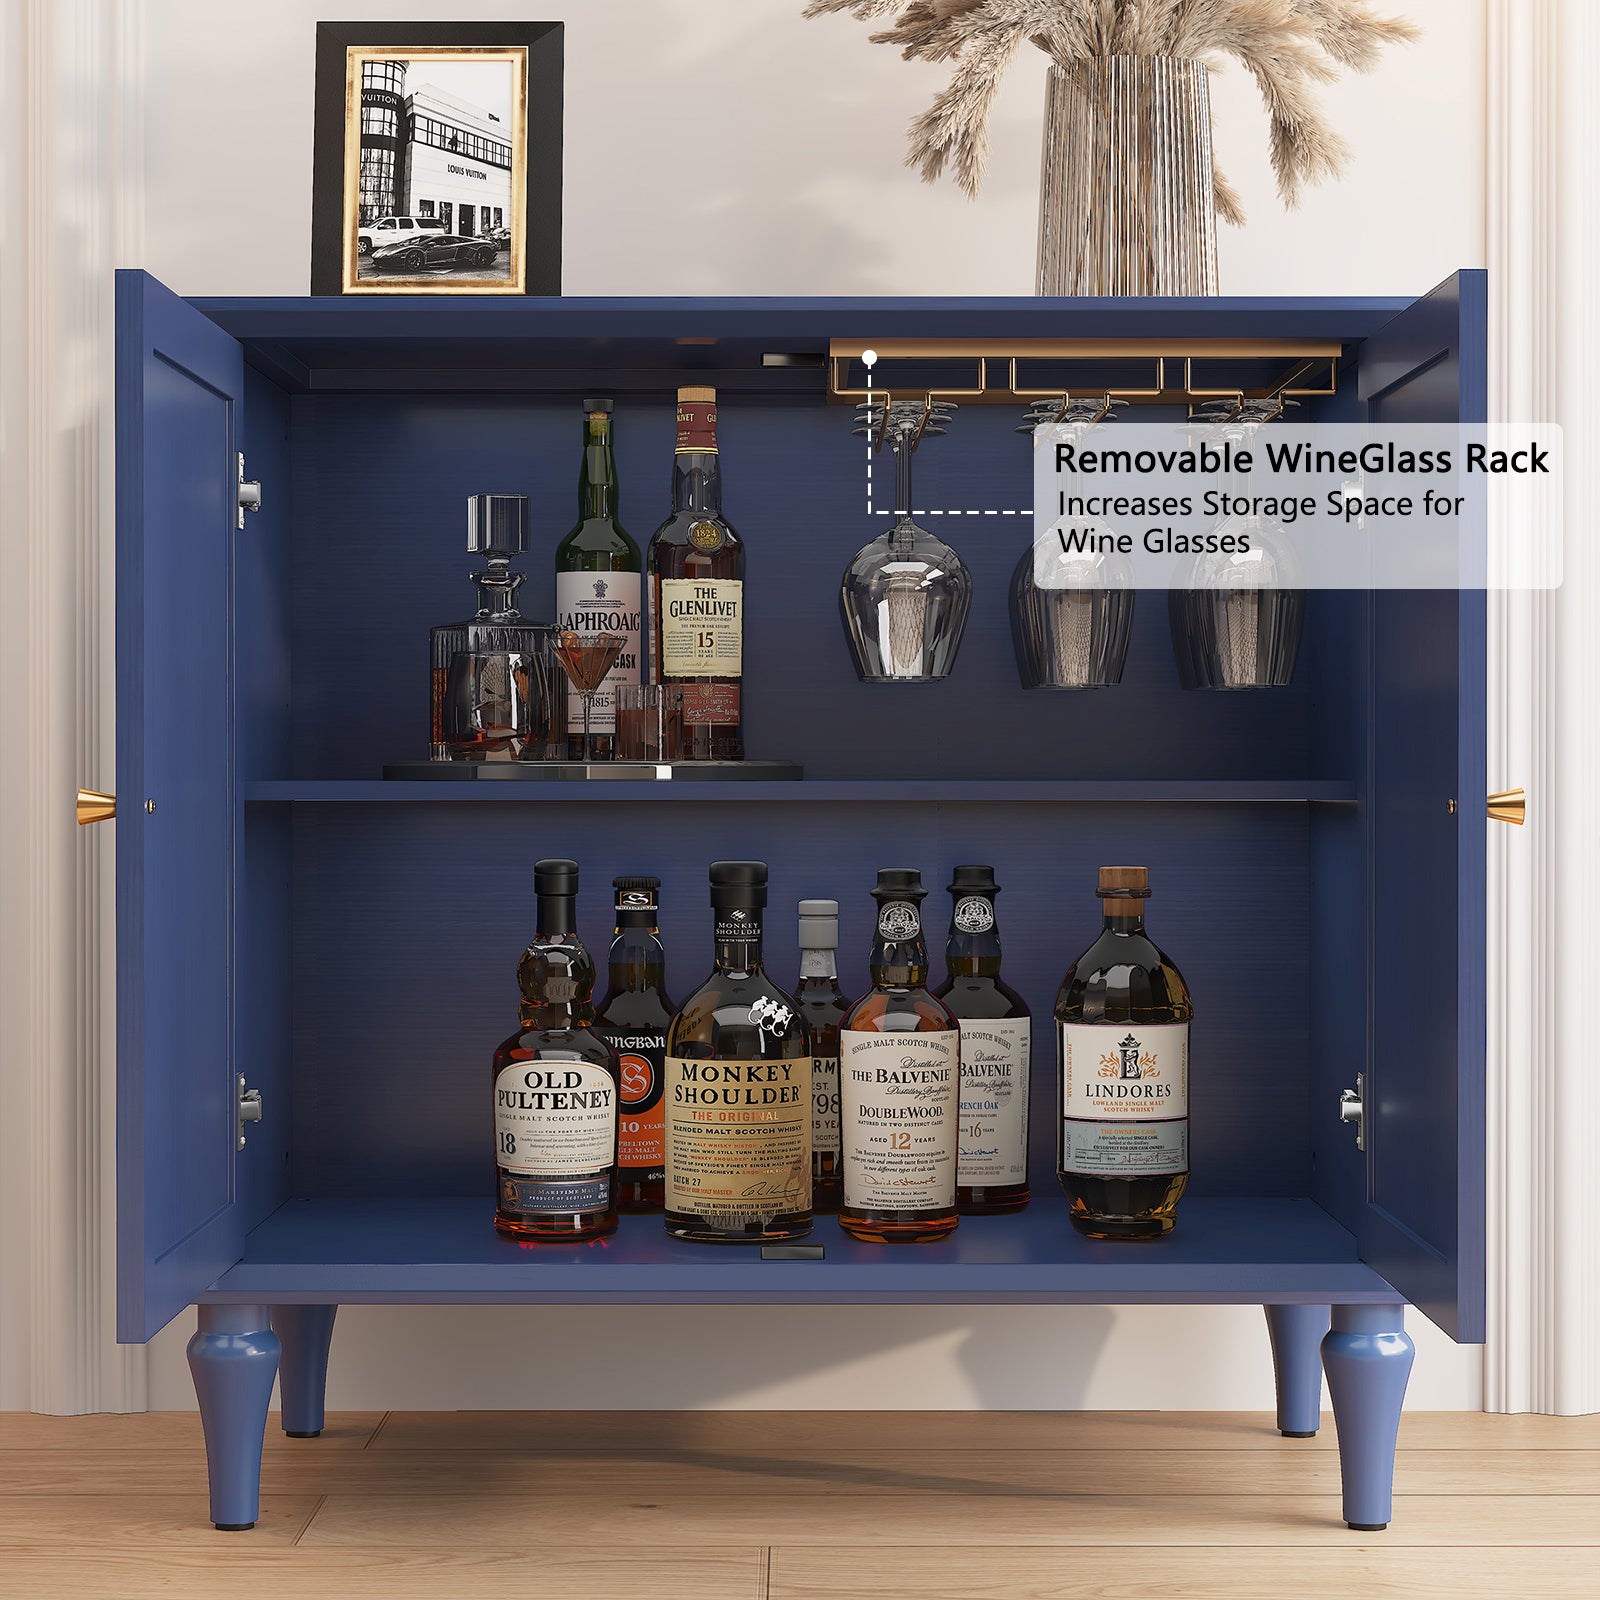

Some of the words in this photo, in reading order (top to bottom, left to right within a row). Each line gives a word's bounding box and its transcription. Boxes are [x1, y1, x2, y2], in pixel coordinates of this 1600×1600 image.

[447, 164, 464, 176] LOUIS
[465, 168, 487, 180] VUITTON
[696, 530, 716, 538] 1824
[694, 588, 718, 599] THE
[670, 600, 737, 618] GLENLIVET
[697, 632, 714, 648] 15
[613, 654, 636, 669] CASK
[591, 697, 610, 708] 1815
[603, 1036, 666, 1048] INGBAN
[972, 1032, 993, 1041] SCOTCH
[852, 1042, 872, 1055] SINGLE
[874, 1039, 895, 1047] MALT
[897, 1039, 928, 1048] SCOTCH
[930, 1042, 950, 1055] WHISKY
[900, 1056, 936, 1068] Distilled
[682, 1063, 792, 1082] MONKEY
[851, 1070, 872, 1082] THE
[875, 1068, 950, 1084] BALVENIE
[960, 1063, 1012, 1077] BALVENIE
[524, 1071, 582, 1089] OLD
[675, 1085, 800, 1104] SHOULDER
[1086, 1084, 1171, 1098] LINDORES
[498, 1090, 611, 1110] PULTENEY
[984, 1100, 999, 1110] OAK
[692, 1111, 712, 1120] THE
[719, 1112, 779, 1122] ORIGINAL
[621, 1122, 640, 1132] 10
[674, 1125, 702, 1133] BLENDED
[969, 1121, 982, 1137] 16
[500, 1132, 516, 1154] 18
[890, 1132, 911, 1150] 12
[674, 1174, 689, 1185] BATCH
[692, 1178, 701, 1186] 27
